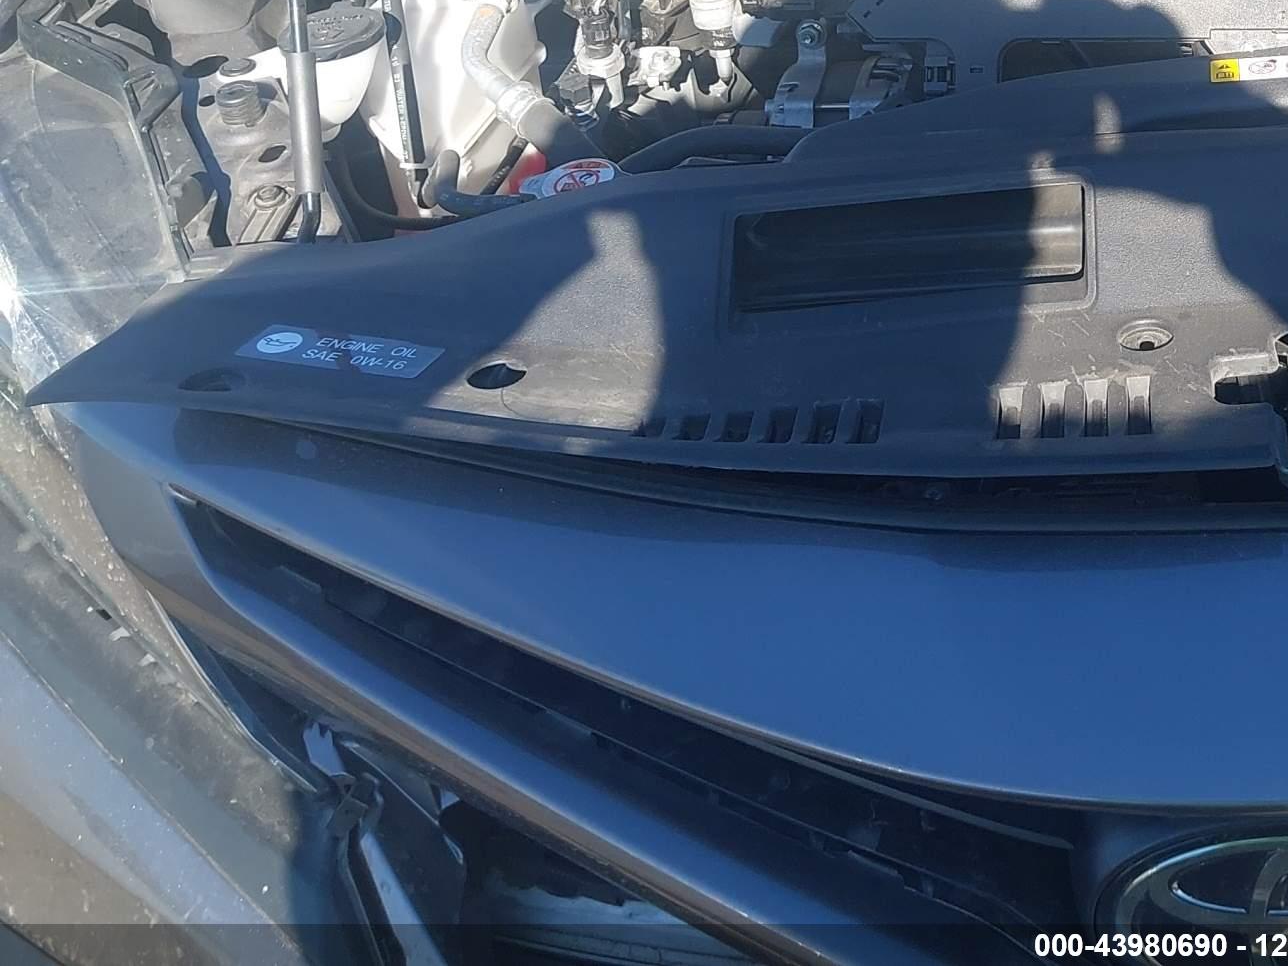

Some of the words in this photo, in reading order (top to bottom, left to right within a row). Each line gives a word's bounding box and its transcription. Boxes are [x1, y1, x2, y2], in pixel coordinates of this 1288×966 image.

[316, 337, 385, 354] ENGINE
[390, 346, 418, 359] OIL
[302, 348, 341, 362] SAE
[350, 354, 408, 371] 0W-16
